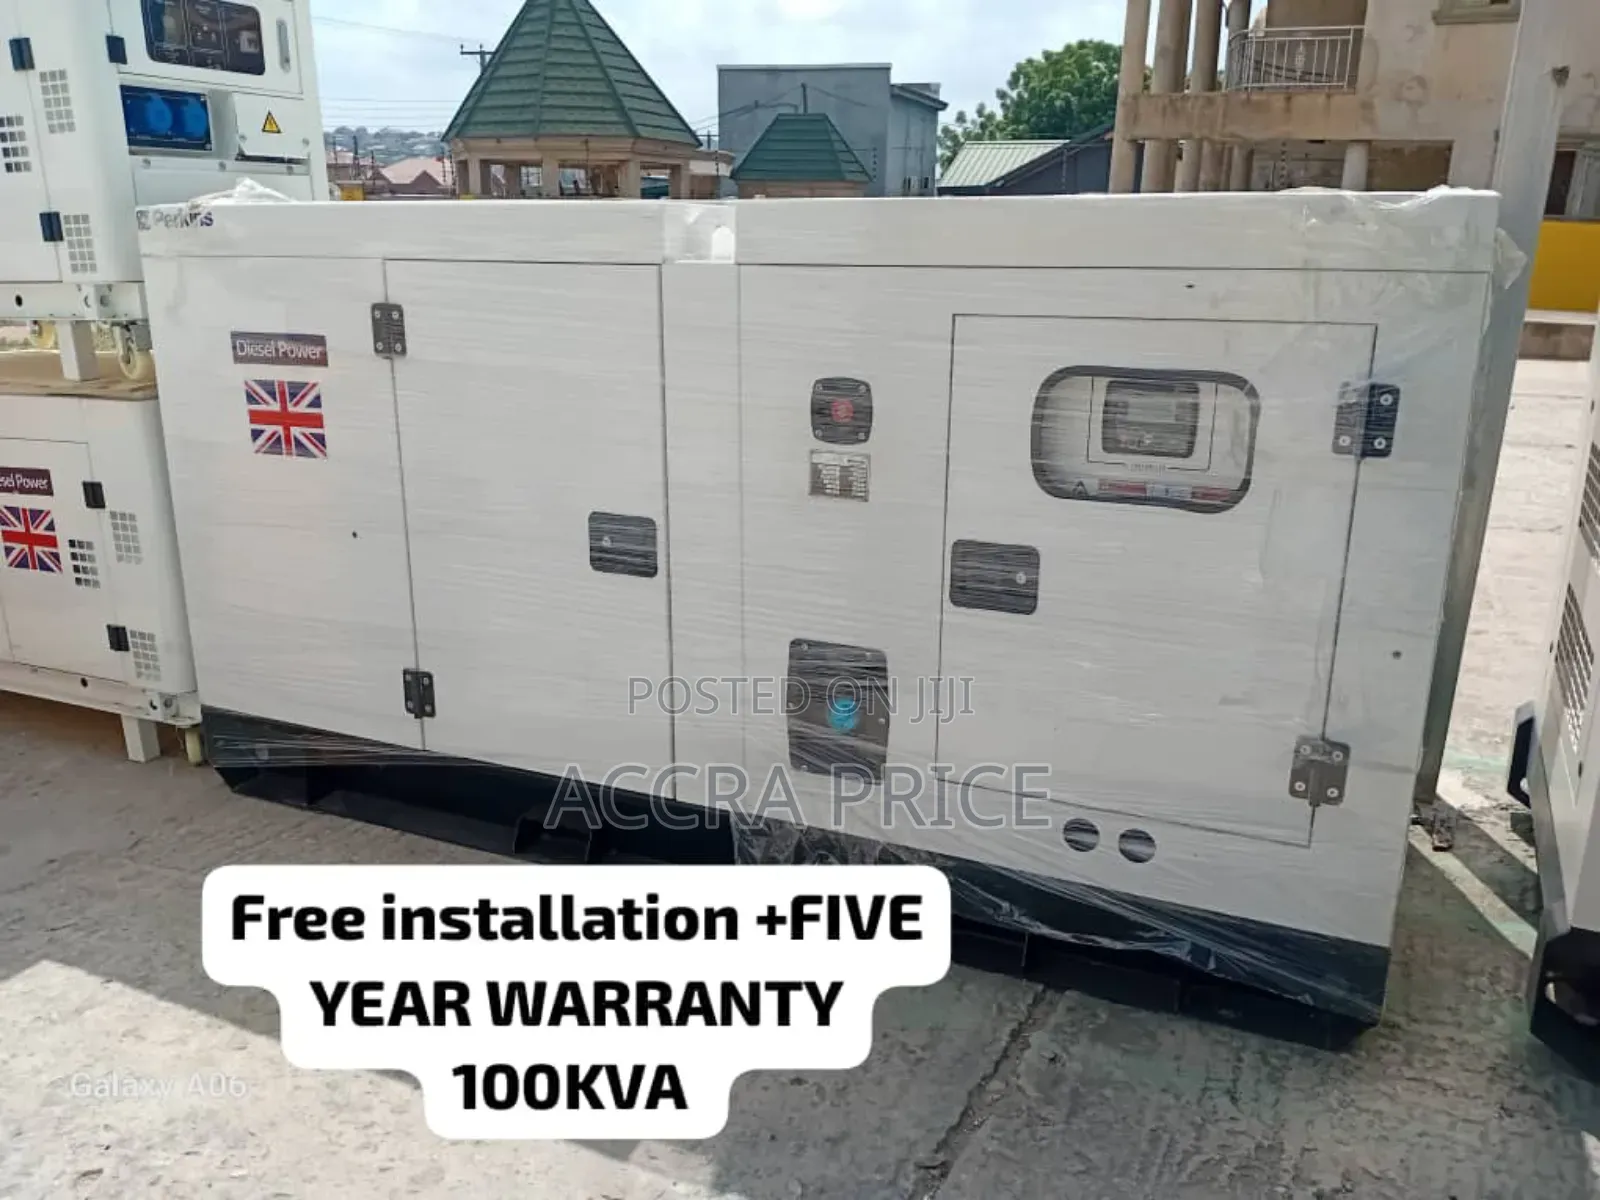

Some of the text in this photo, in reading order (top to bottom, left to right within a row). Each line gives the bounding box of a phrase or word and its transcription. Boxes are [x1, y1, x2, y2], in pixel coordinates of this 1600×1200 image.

[236, 340, 323, 359] Diesel Power
[15, 473, 48, 490] Power
